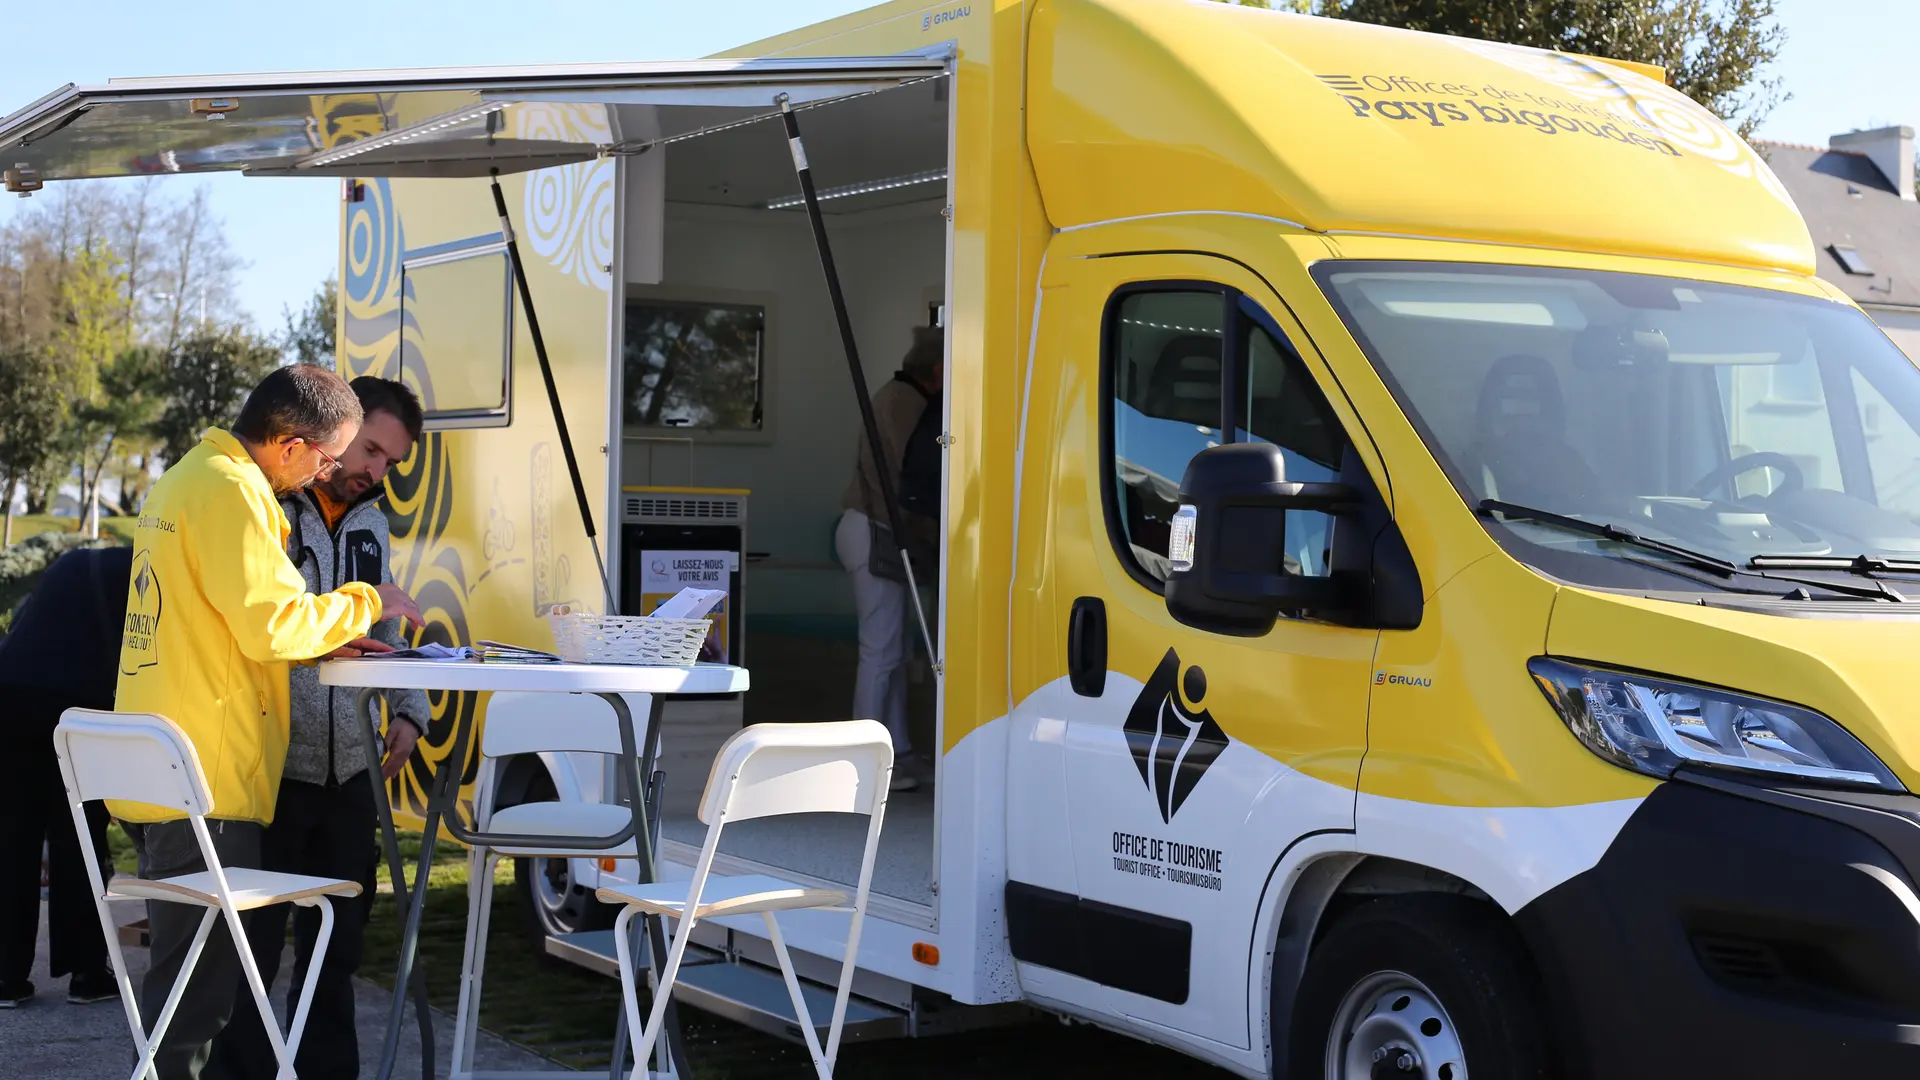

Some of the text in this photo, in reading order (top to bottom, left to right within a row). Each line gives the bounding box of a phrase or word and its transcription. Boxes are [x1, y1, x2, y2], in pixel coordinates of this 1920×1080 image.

[934, 5, 971, 25] GRUAU
[1362, 75, 1478, 97] Offices
[1482, 84, 1524, 102] de
[1336, 92, 1683, 157] Pays bigouden
[672, 559, 724, 570] LAISSEZ-NOUS
[678, 571, 700, 581] VOTRE
[702, 571, 719, 581] AVIS
[1388, 674, 1432, 687] GRUAU
[1112, 831, 1222, 873] OFFICE DE TOURISME
[1112, 856, 1222, 891] TOURIST OFFICE TOURISMUSBÜRO
